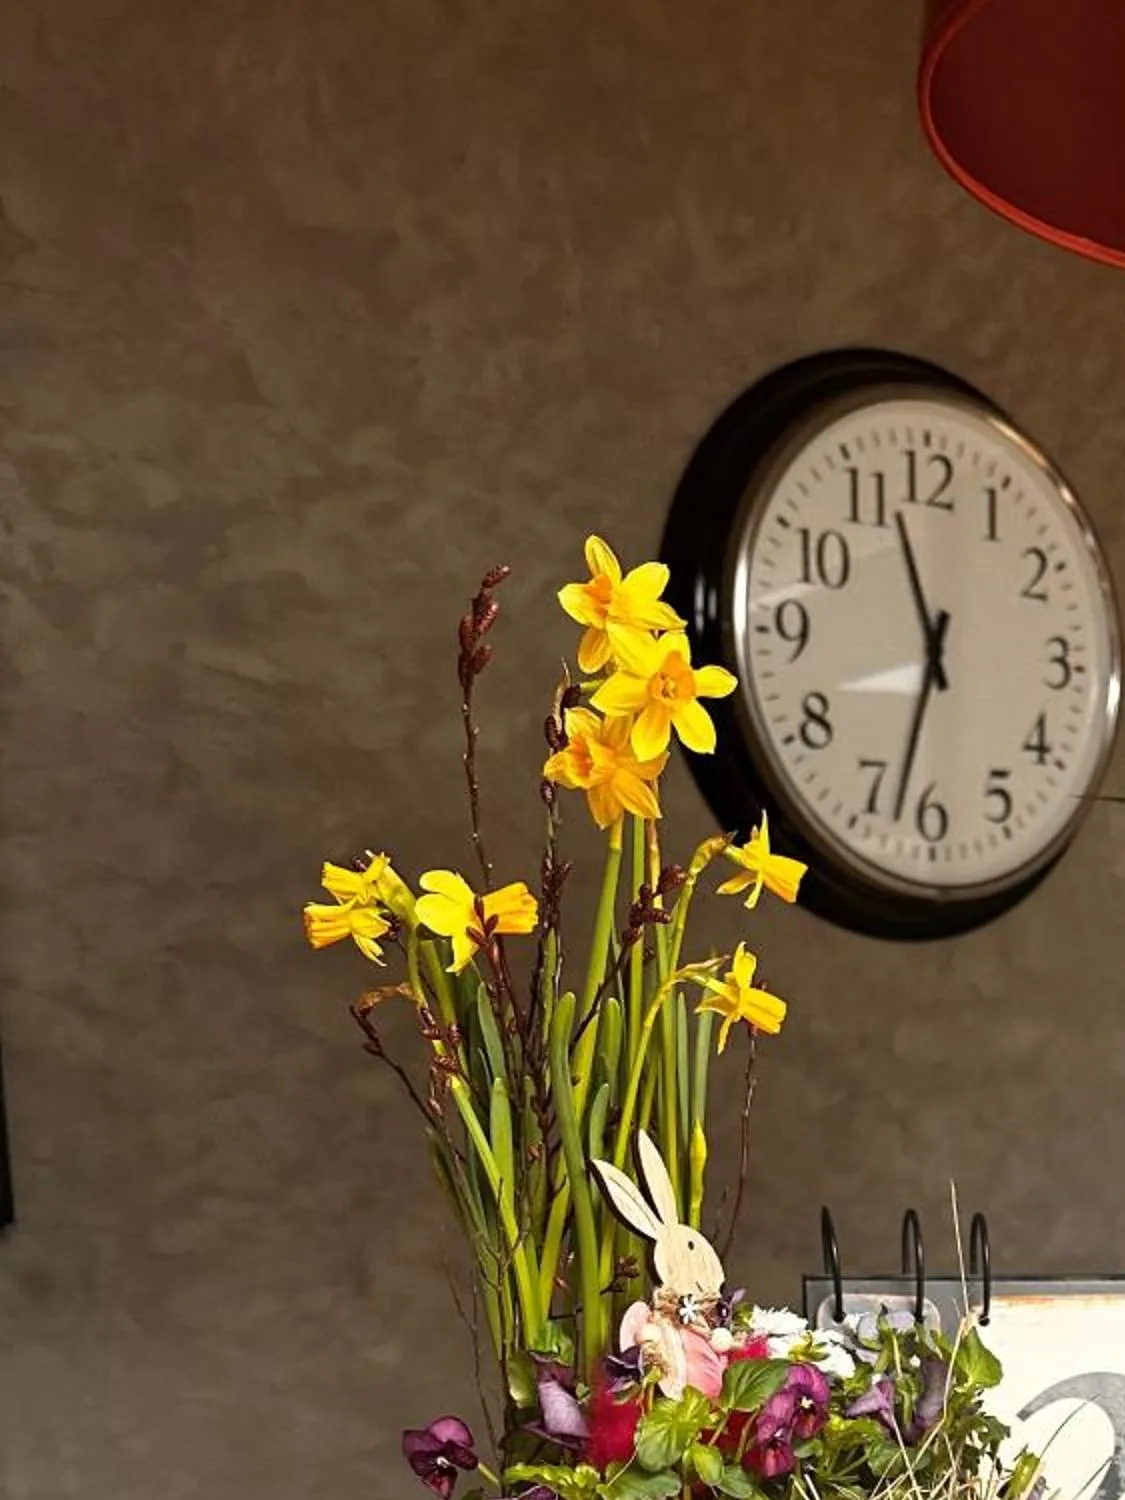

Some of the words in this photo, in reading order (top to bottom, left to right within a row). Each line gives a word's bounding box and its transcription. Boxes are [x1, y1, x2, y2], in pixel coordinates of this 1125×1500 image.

[846, 467, 889, 528] 11
[902, 449, 954, 511] 12
[983, 488, 1000, 541] 1
[800, 529, 850, 590] 10
[1021, 547, 1048, 601] 2
[775, 600, 810, 664] 9
[1045, 637, 1070, 690] 3
[801, 692, 833, 749] 8
[1023, 712, 1052, 765] 4
[857, 759, 887, 815] 7
[915, 781, 948, 842] 6
[984, 770, 1012, 824] 5
